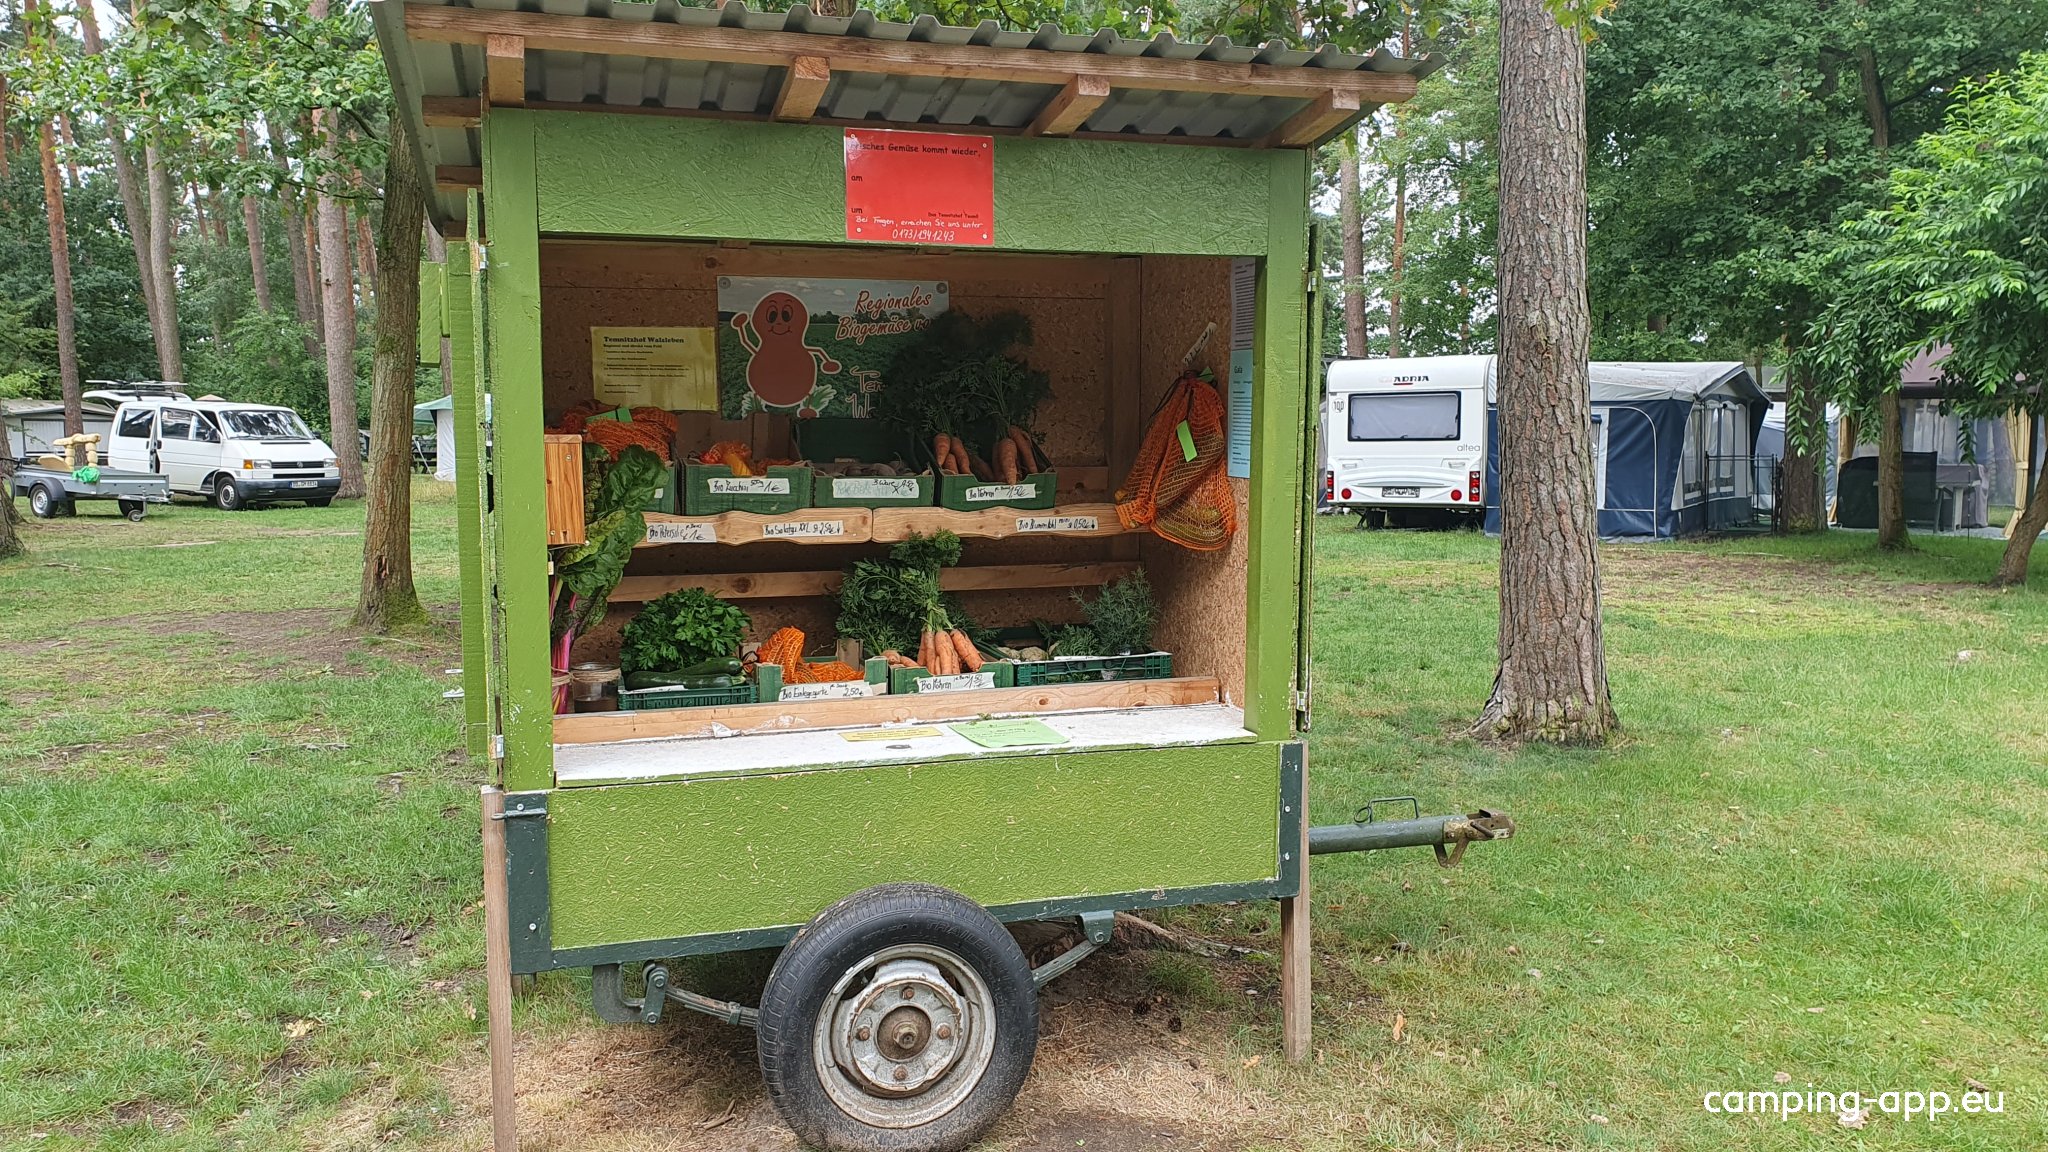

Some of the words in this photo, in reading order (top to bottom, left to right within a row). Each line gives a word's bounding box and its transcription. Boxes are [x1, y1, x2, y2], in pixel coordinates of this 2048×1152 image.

[888, 142, 919, 153] Gemüse
[922, 143, 948, 154] kommt
[935, 218, 945, 227] Sie
[892, 229, 955, 241] 0173/1941243
[855, 286, 932, 320] Regionales
[836, 315, 912, 345] Biogemüse
[1457, 443, 1481, 452] altea
[713, 481, 724, 493] Bio
[765, 525, 774, 535] Bio
[1018, 519, 1029, 530] Bio
[649, 525, 659, 539] Bio
[920, 679, 932, 691] Bio
[782, 688, 792, 700] Bio
